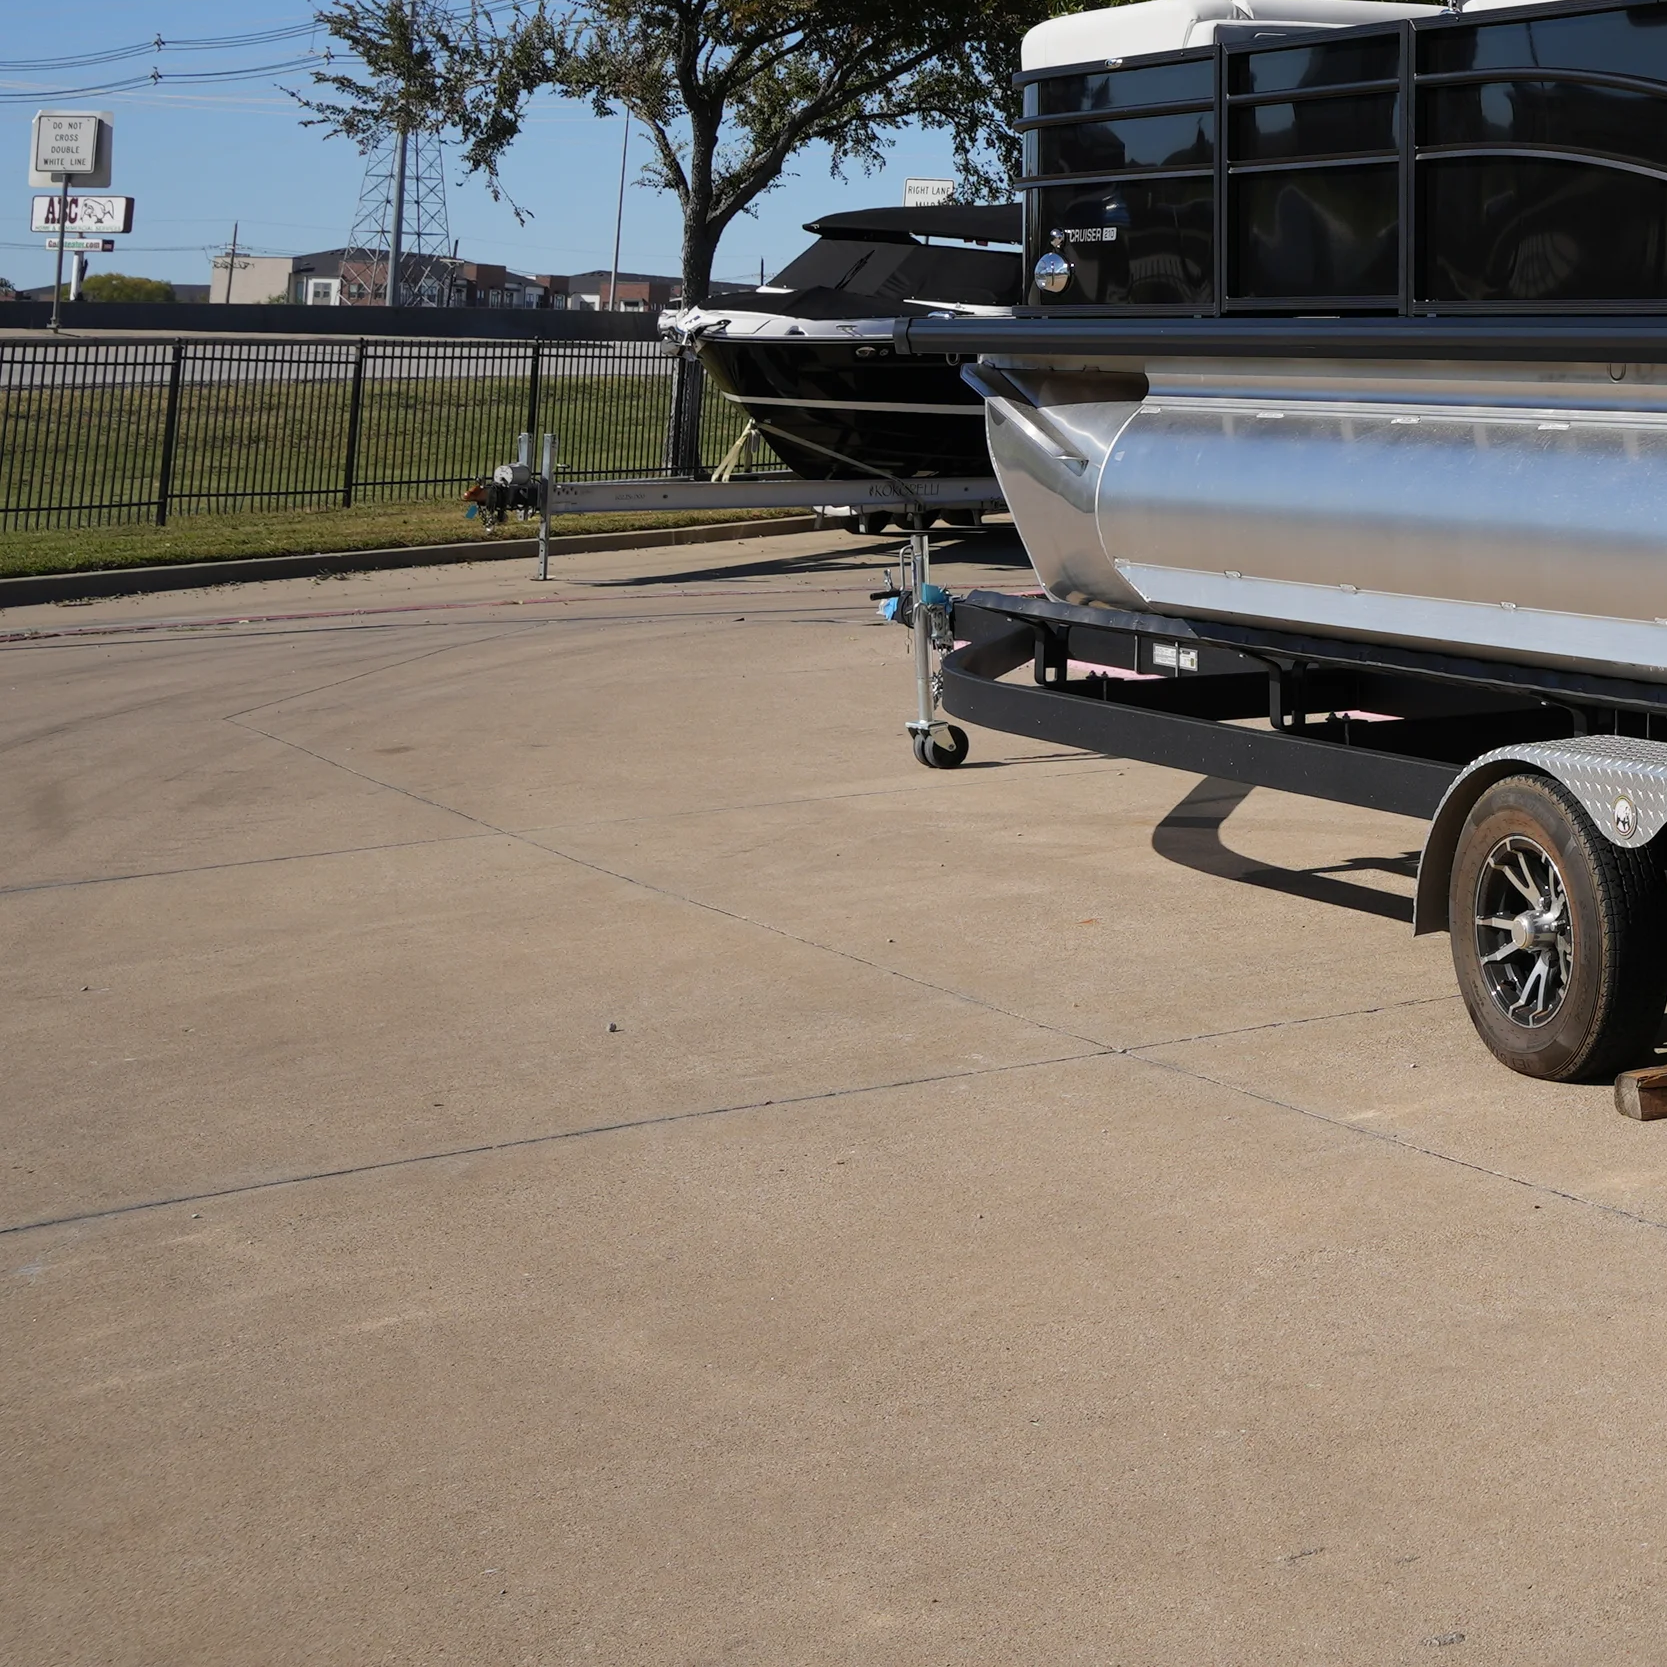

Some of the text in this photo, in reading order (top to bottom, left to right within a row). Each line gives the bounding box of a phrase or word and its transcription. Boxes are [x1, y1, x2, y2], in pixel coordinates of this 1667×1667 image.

[52, 122, 82, 130] DO NOT
[54, 134, 79, 142] CROSS
[50, 146, 80, 154] DOUBLE
[43, 158, 87, 166] WHITE LINE
[907, 186, 951, 196] RIGHT LANE
[1069, 227, 1102, 243] CRUISER
